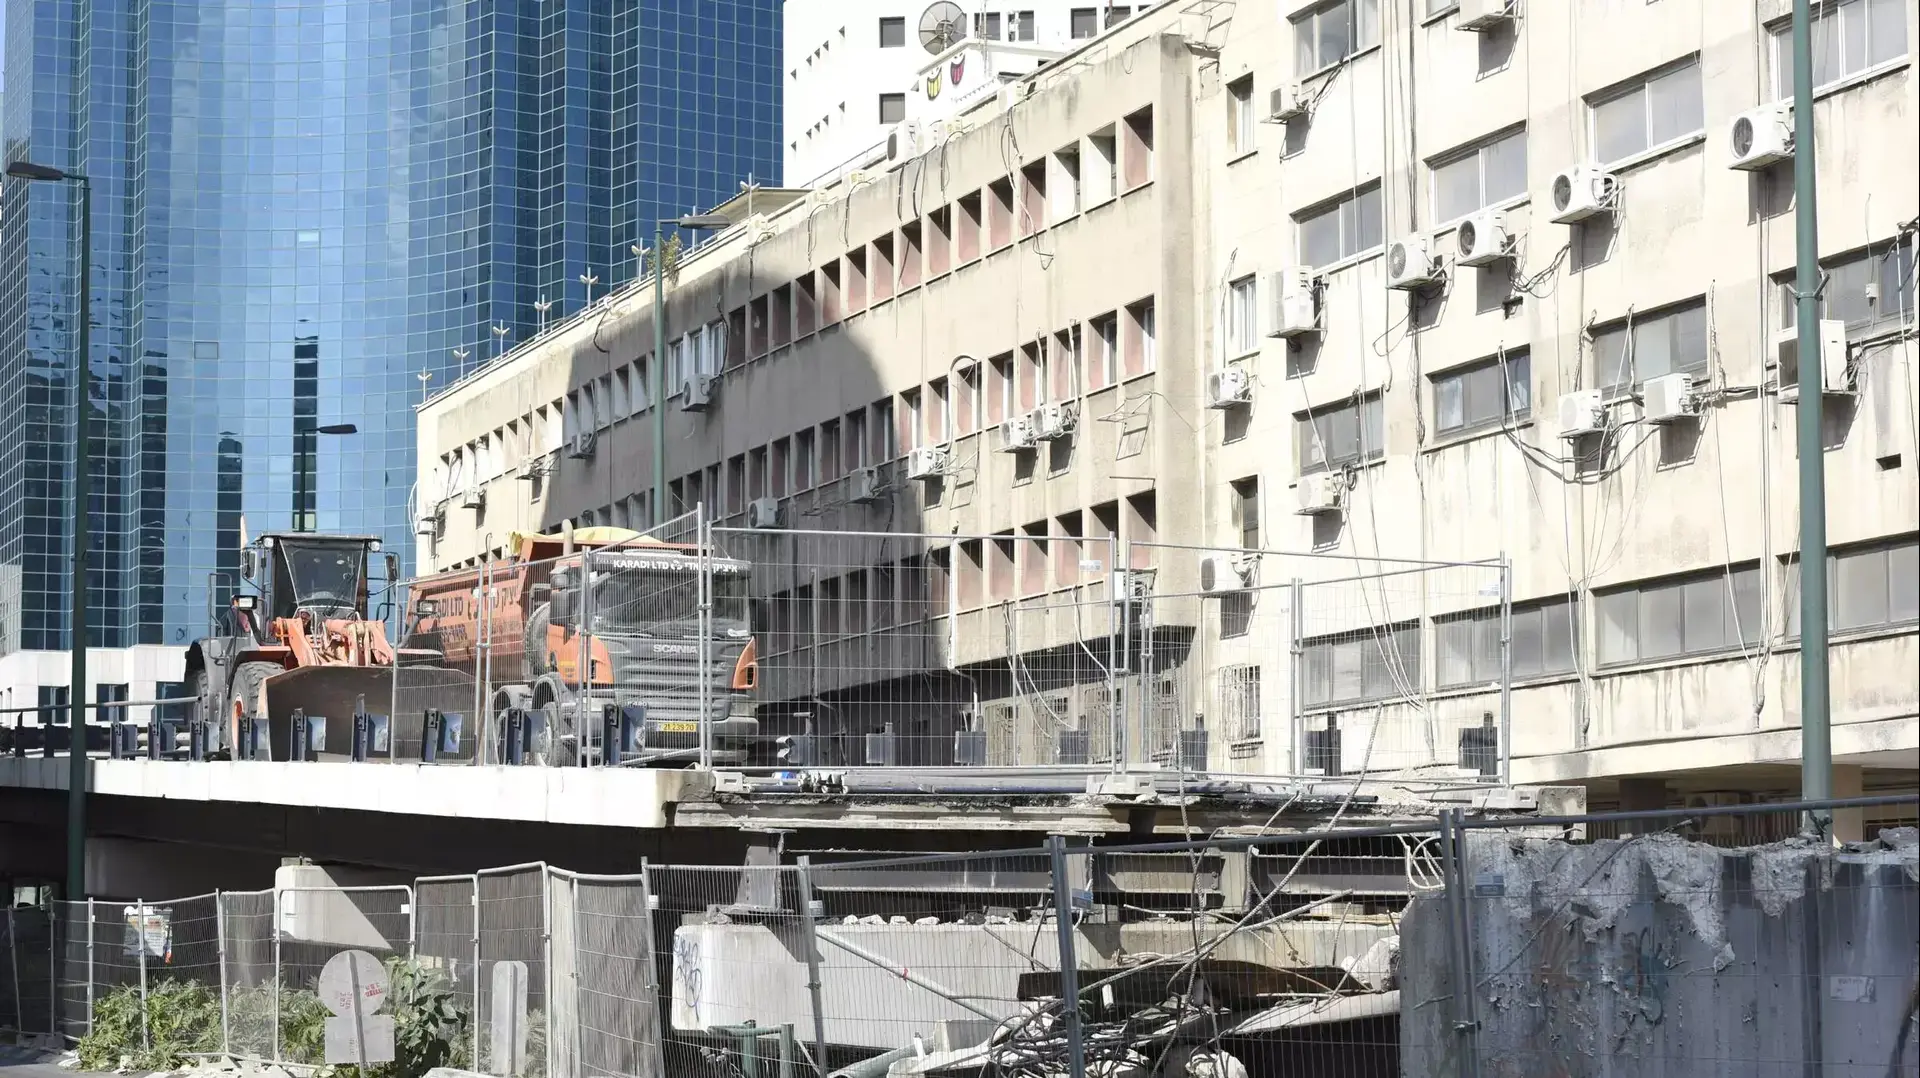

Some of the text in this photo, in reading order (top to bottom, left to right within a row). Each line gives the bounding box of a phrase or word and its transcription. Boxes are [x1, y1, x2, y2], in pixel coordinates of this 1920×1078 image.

[613, 559, 650, 569] KARADI
[652, 561, 670, 570] LTD
[653, 644, 698, 654] SCANIA
